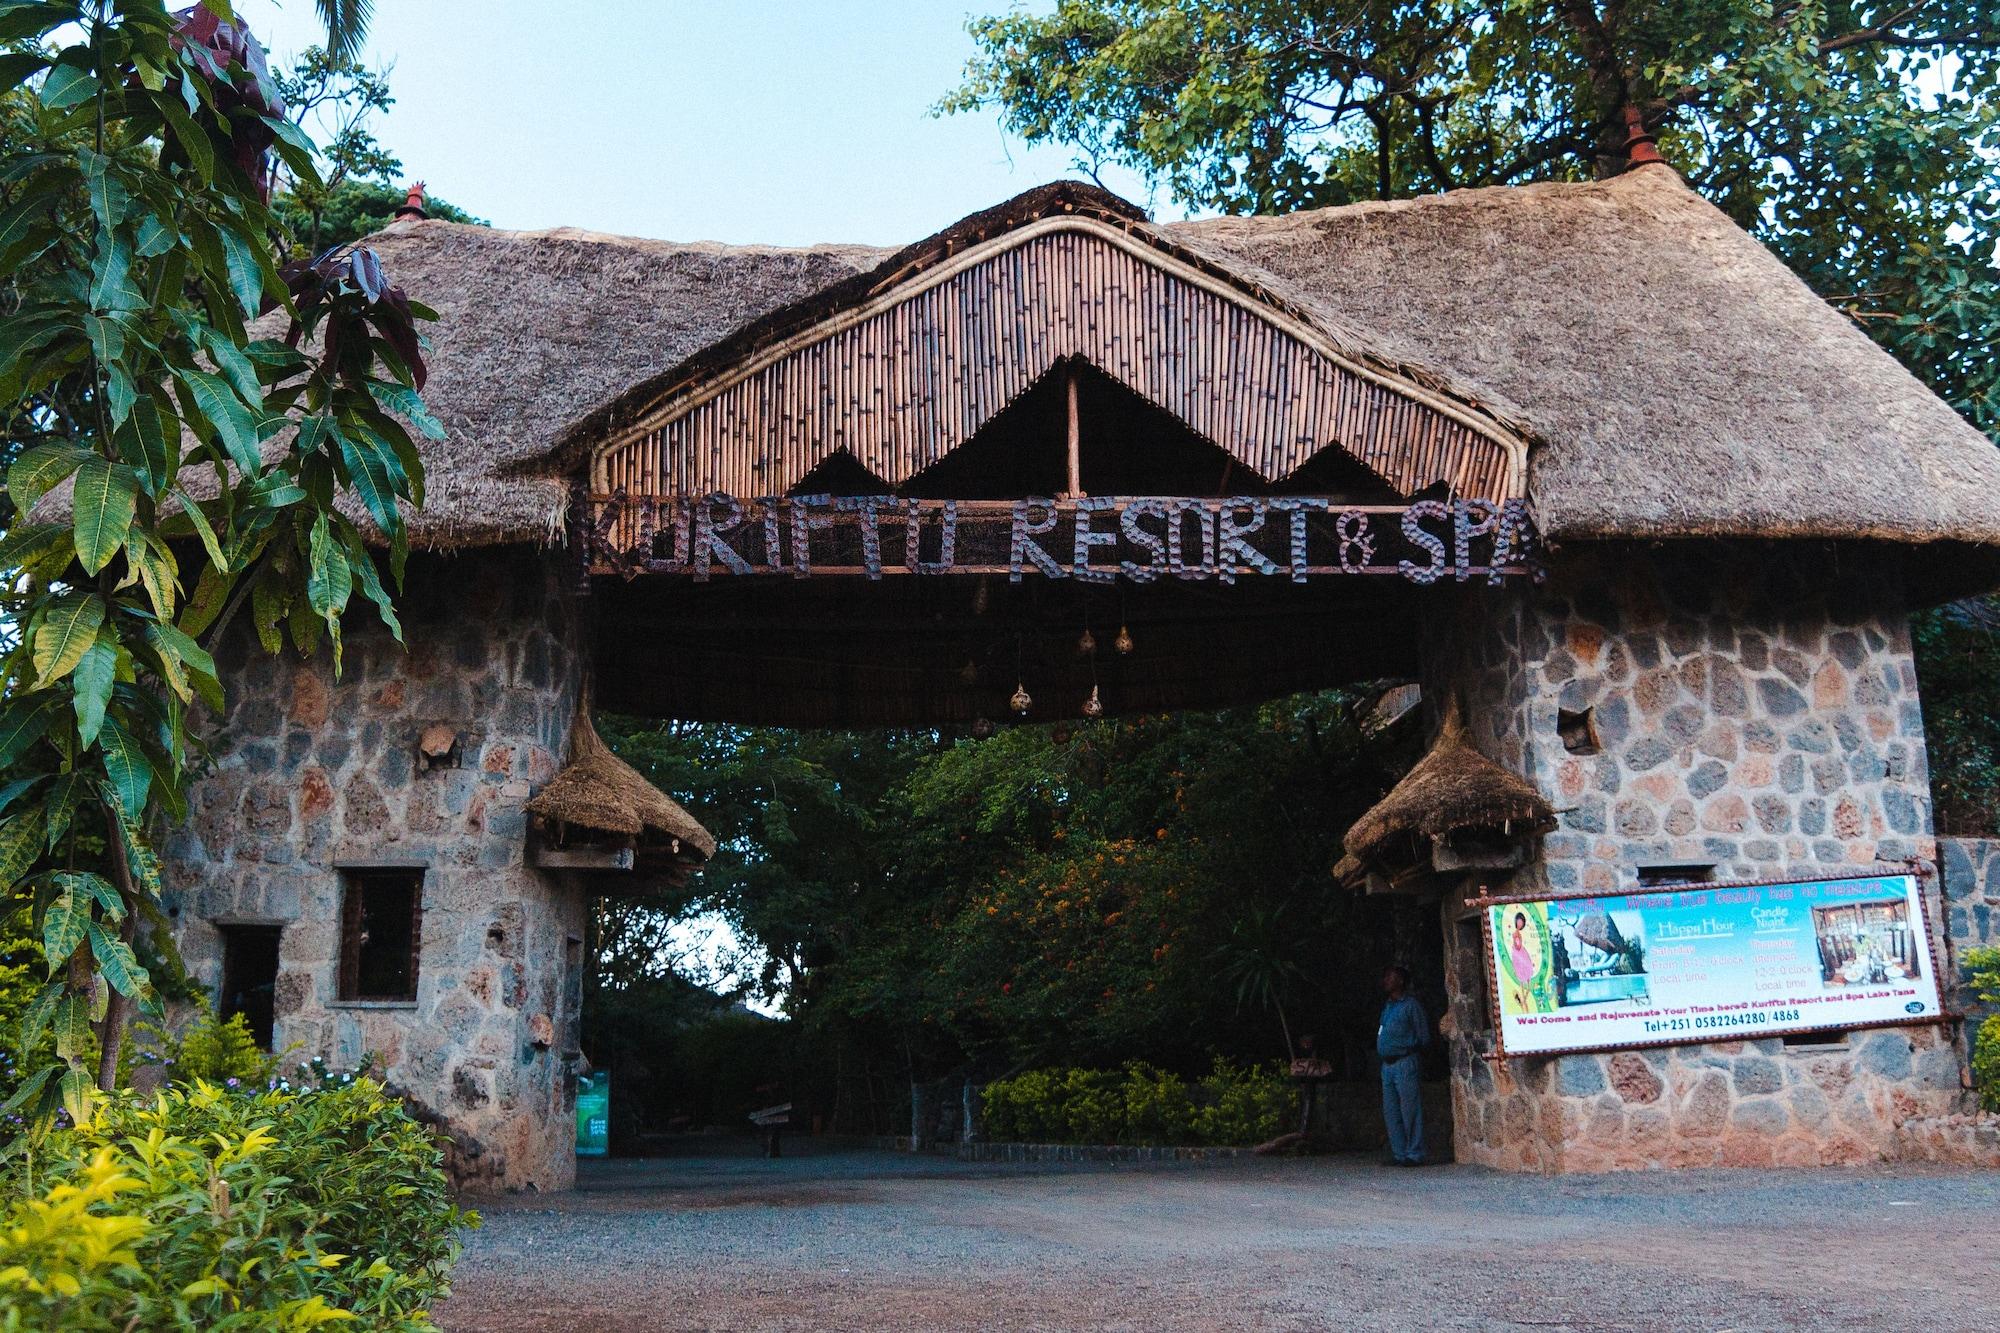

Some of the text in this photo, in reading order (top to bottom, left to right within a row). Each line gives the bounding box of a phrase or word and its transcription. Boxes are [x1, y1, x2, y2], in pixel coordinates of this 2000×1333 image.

[575, 484, 1547, 594] KURIFTU RESORT & SPA
[1769, 886, 1793, 899] has
[1801, 886, 1818, 897] no
[1825, 882, 1884, 897] measure
[1750, 906, 1789, 918] Candle
[1658, 918, 1735, 937] Happy Hour
[1756, 917, 1786, 928] Night
[1653, 971, 1707, 984] Local time
[1755, 979, 1807, 991] Local time
[1516, 1014, 1538, 1025] Wel
[1540, 1015, 1572, 1024] Come
[1577, 1013, 1597, 1022] and
[1600, 1009, 1661, 1021] Rejuvenate
[1663, 1007, 1687, 1016] Your
[1690, 1005, 1715, 1014] Time
[1751, 998, 1787, 1009] Kuriftu
[1789, 995, 1823, 1006] Resort
[1825, 993, 1843, 1003] and
[1846, 991, 1864, 1001] Spa
[1867, 989, 1890, 999] Lake
[1893, 987, 1916, 996] Tana
[1644, 1017, 1691, 1032] Tel+251
